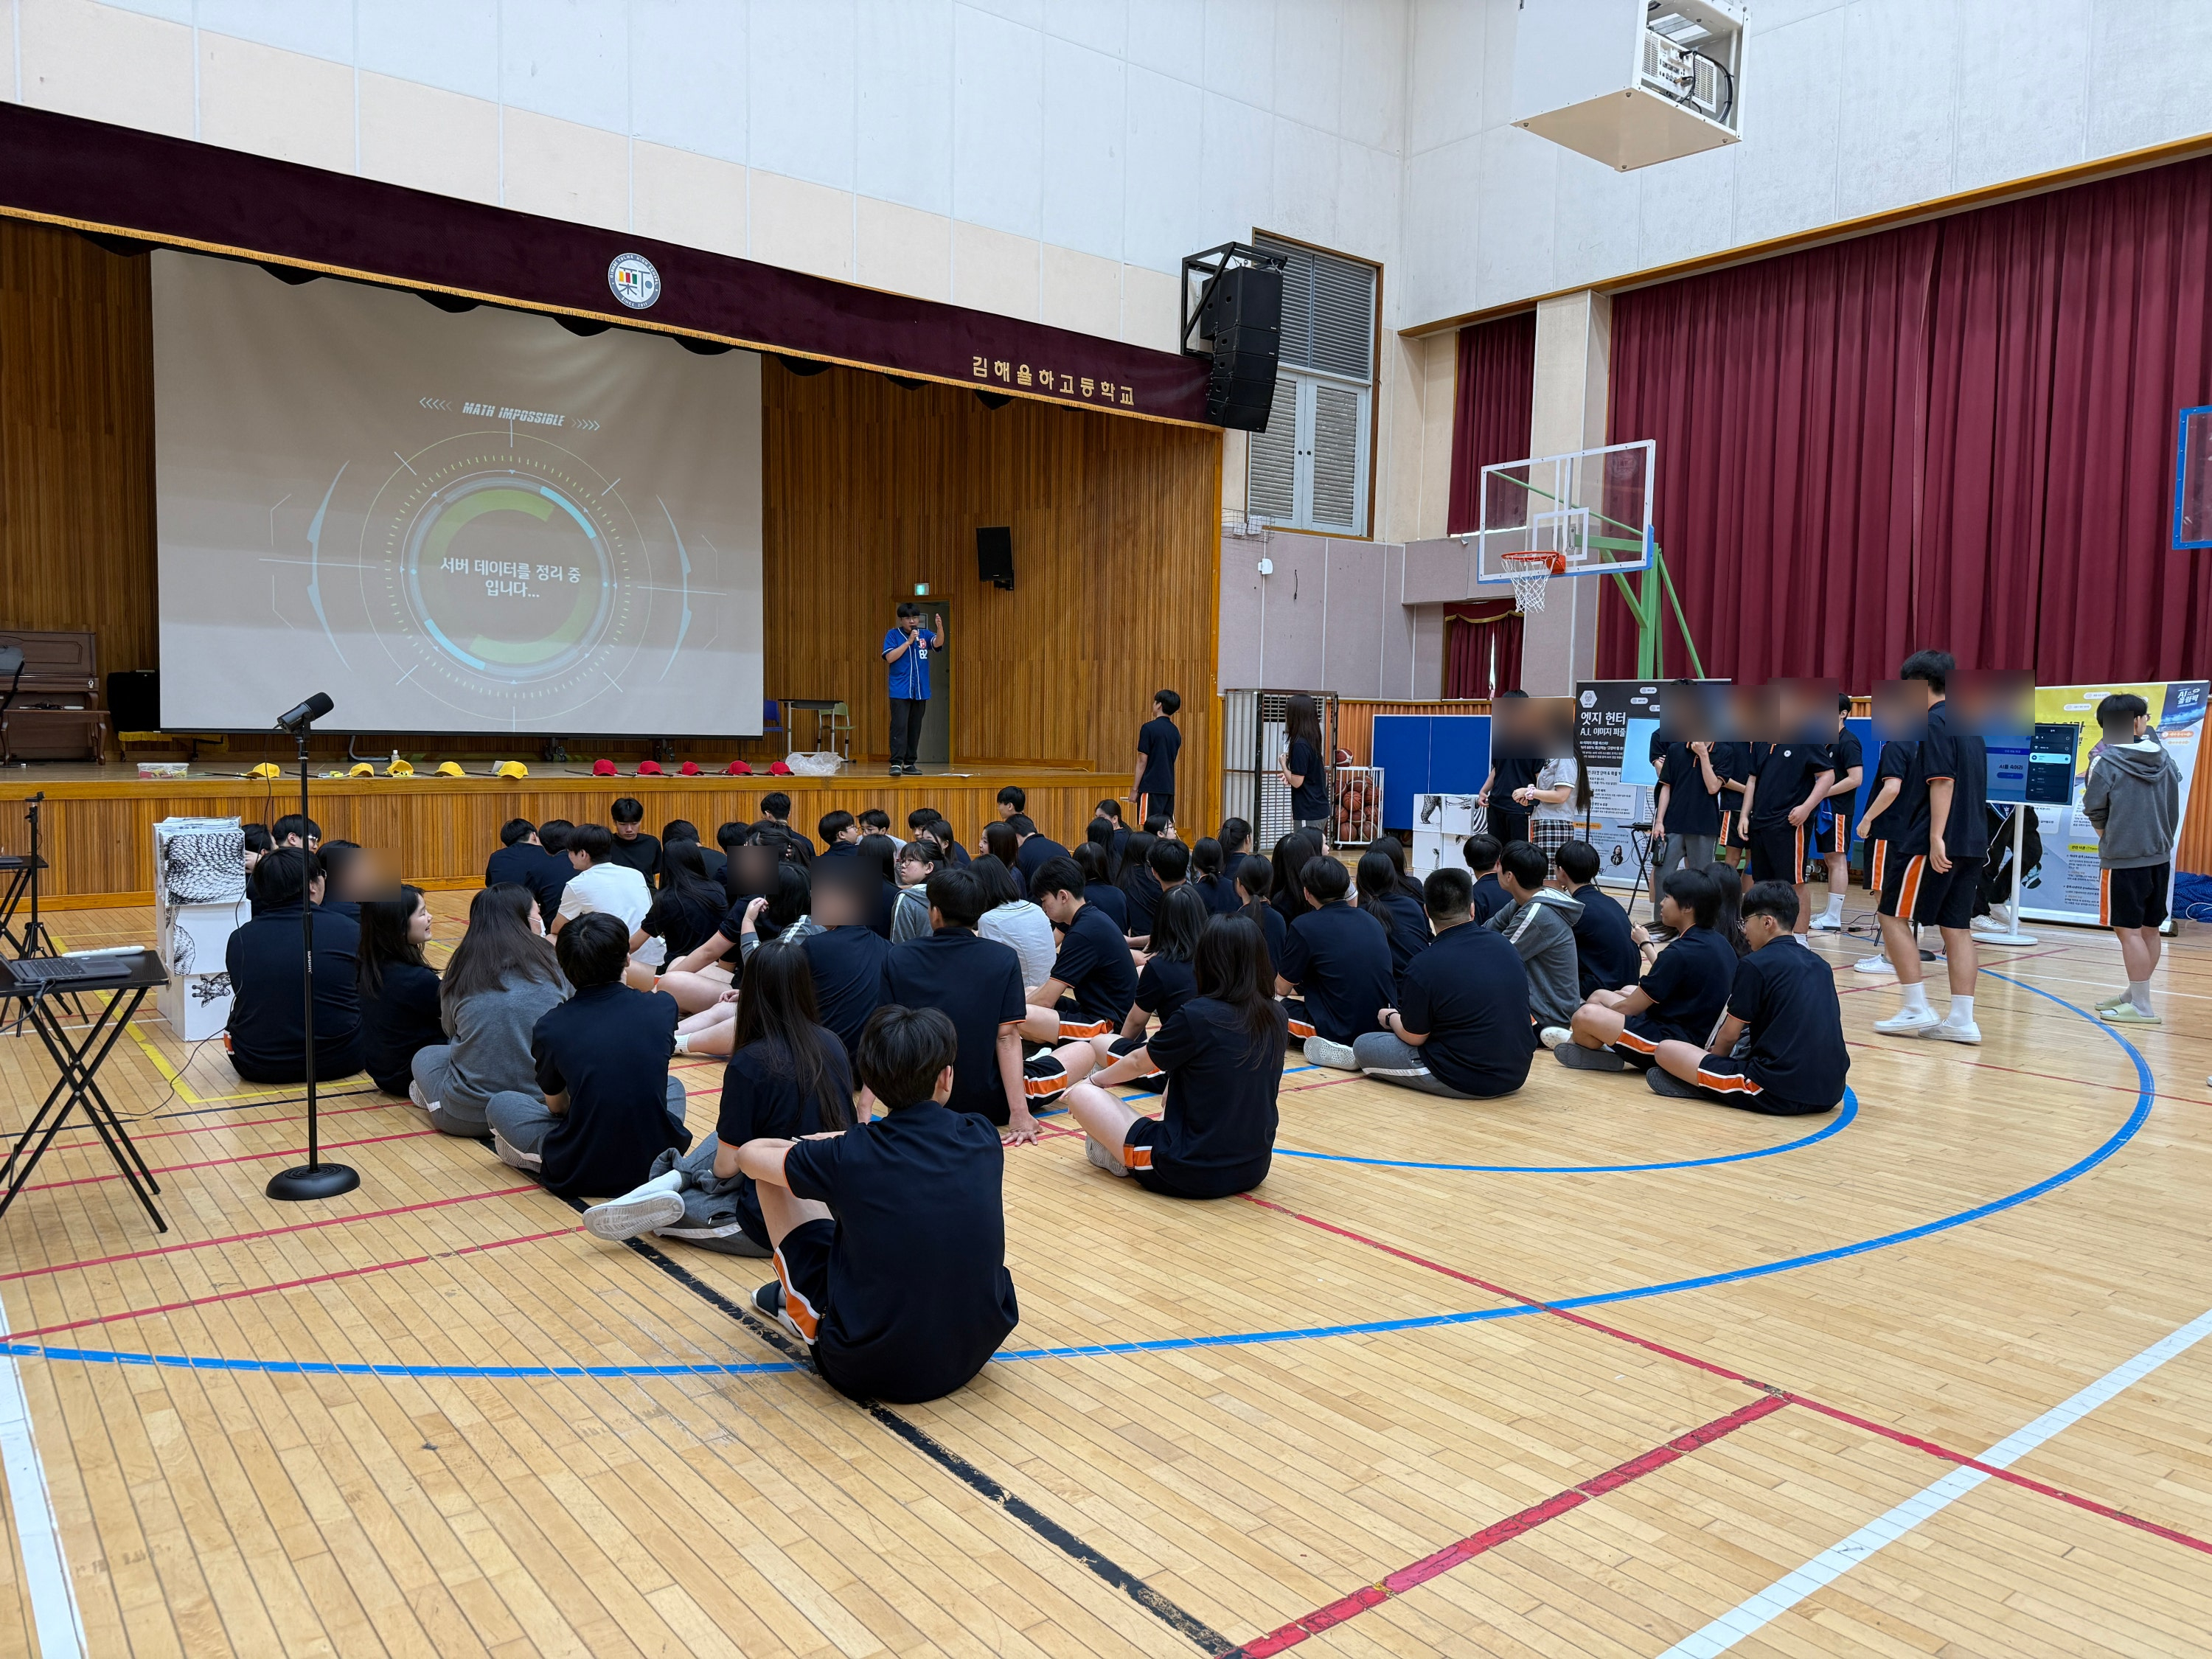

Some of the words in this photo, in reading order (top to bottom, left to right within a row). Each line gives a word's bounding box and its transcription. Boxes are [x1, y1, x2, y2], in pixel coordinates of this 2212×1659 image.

[973, 356, 1134, 406] 김해율하고등학교
[462, 402, 495, 417] MATH
[498, 407, 565, 427] IMPOSSIBLE
[440, 557, 469, 574] 서버
[474, 560, 531, 580] 데이터를
[536, 564, 563, 582] 정리
[567, 566, 581, 583] 중
[485, 580, 540, 598] 입니다...
[2177, 690, 2188, 698] AI
[1581, 712, 1601, 726] 엣지
[1605, 712, 1626, 726] 헌터
[1580, 728, 1591, 736] A.I.
[1593, 728, 1612, 736] 이미지
[1613, 728, 1626, 737] 퍼즐
